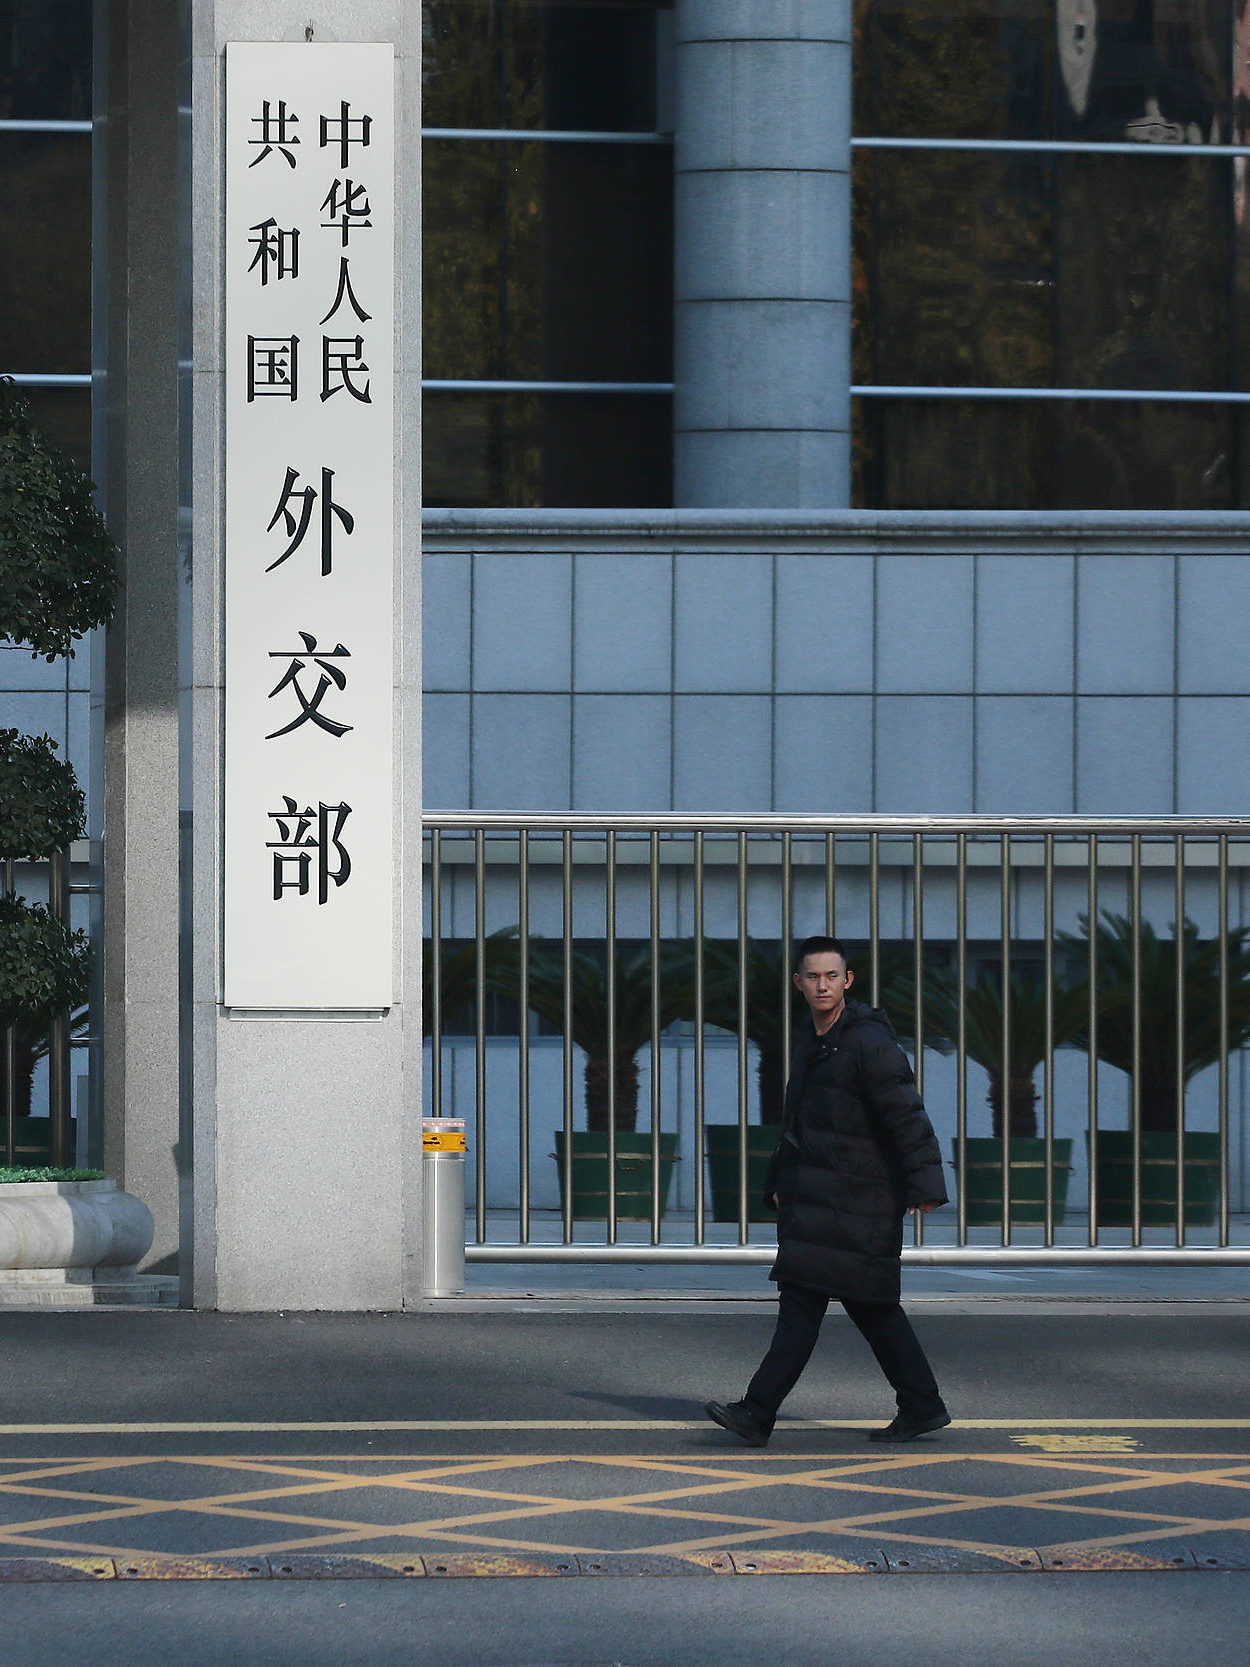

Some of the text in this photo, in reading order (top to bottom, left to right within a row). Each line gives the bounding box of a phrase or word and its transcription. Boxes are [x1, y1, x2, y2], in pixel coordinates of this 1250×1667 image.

[247, 99, 301, 404] 共和国
[319, 100, 373, 404] 中华人民
[264, 465, 355, 906] 外交部
